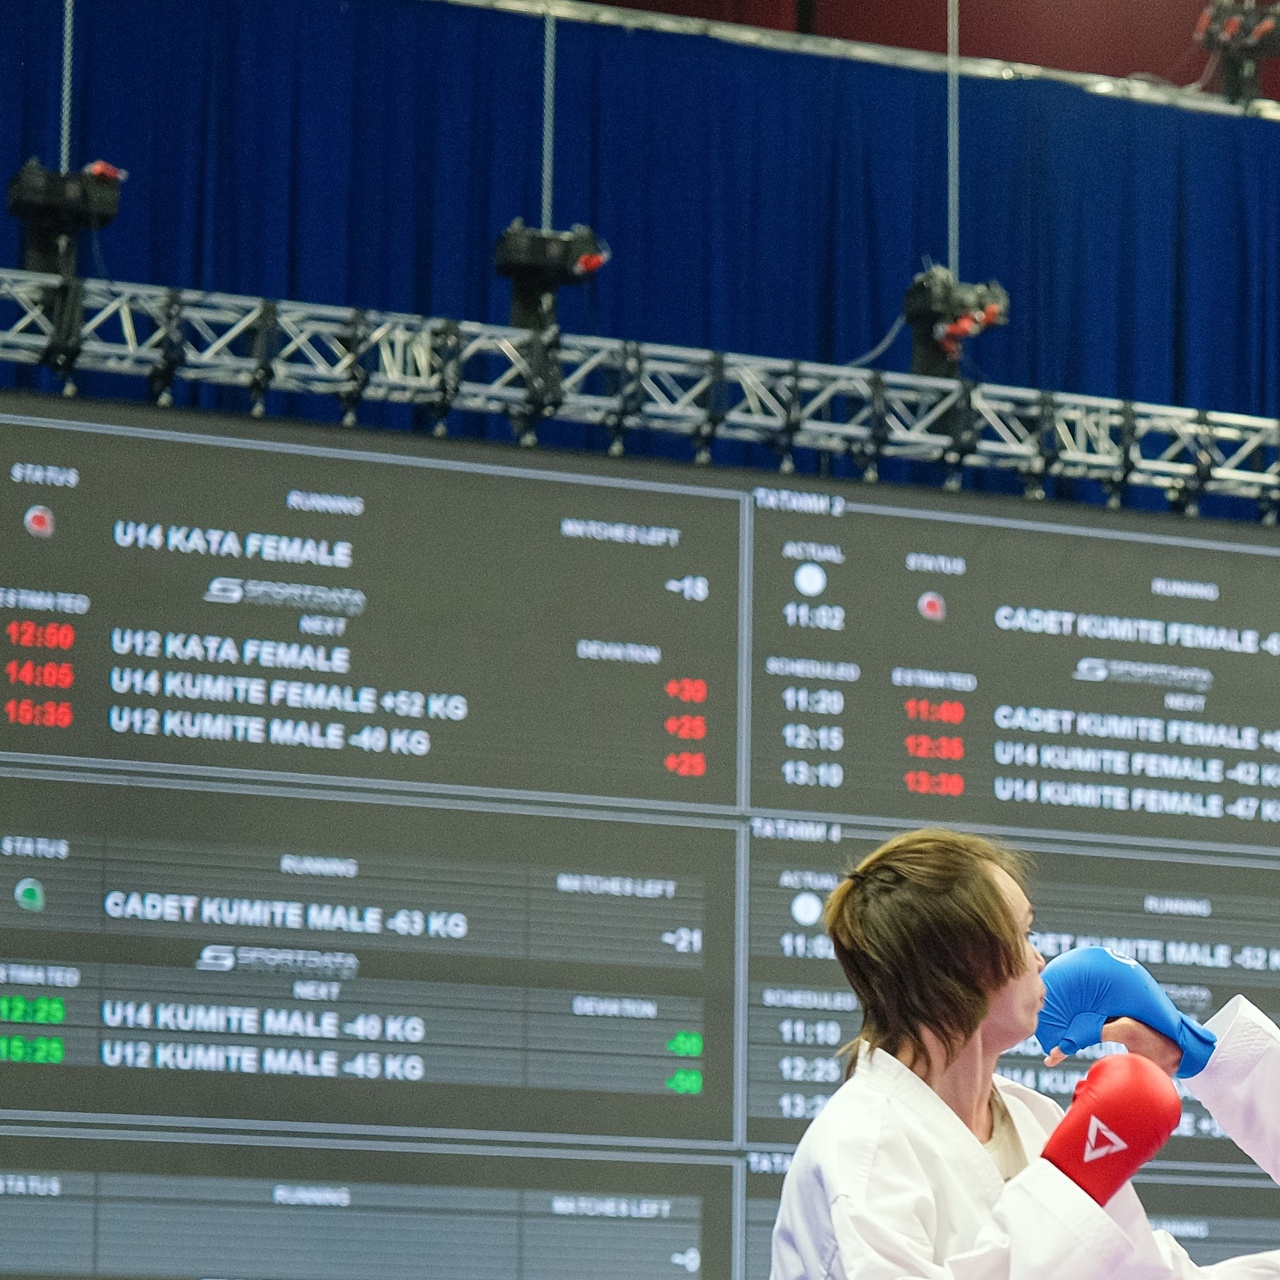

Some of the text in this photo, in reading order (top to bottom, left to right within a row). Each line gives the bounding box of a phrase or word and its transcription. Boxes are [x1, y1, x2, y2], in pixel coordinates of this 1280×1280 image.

[10, 462, 80, 488] STATUS
[753, 486, 830, 515] TATAMI
[113, 520, 353, 568] U14 KATA FEMALE
[905, 552, 967, 575] STATUS
[300, 614, 347, 637] NEXT
[995, 605, 1076, 636] CADET
[1077, 614, 1165, 646] KUMITE
[1167, 622, 1259, 655] FEMALE
[110, 627, 351, 674] U12 KATA FEMALE
[6, 660, 74, 689] 14:05
[110, 666, 159, 696] U14
[163, 670, 267, 706] KUMITE
[270, 681, 377, 714] FEMALE
[427, 694, 468, 721] KG
[108, 705, 158, 735] U12
[162, 709, 266, 745] KUMITE
[269, 717, 345, 750] MALE
[389, 729, 431, 756] KG
[782, 723, 844, 752] 12:15
[994, 704, 1076, 734] CADET
[1077, 711, 1165, 743] KUMITE
[1166, 719, 1259, 751] FEMALE
[994, 740, 1038, 767] U14
[1040, 744, 1129, 775] KUMITE
[1131, 751, 1224, 783] FEMALE
[994, 776, 1038, 802] U14
[1040, 780, 1129, 810] KUMITE
[1131, 787, 1224, 818] FEMALE
[751, 817, 827, 843] TATAMI
[0, 836, 70, 860] STATUS
[103, 891, 199, 922] CADET
[201, 897, 304, 928] KUMITE
[306, 904, 383, 934] MALE
[427, 911, 468, 939] KG
[1166, 940, 1232, 968] MALE
[292, 980, 341, 1001] NEXT
[101, 999, 151, 1029] U14
[155, 1003, 259, 1035] KUMITE
[263, 1009, 339, 1039] MALE
[384, 1015, 425, 1043] KG
[101, 1039, 151, 1067] U12
[154, 1042, 259, 1073] KUMITE
[262, 1048, 339, 1077] MALE
[384, 1054, 425, 1081] KG
[0, 1175, 61, 1197] TATUS
